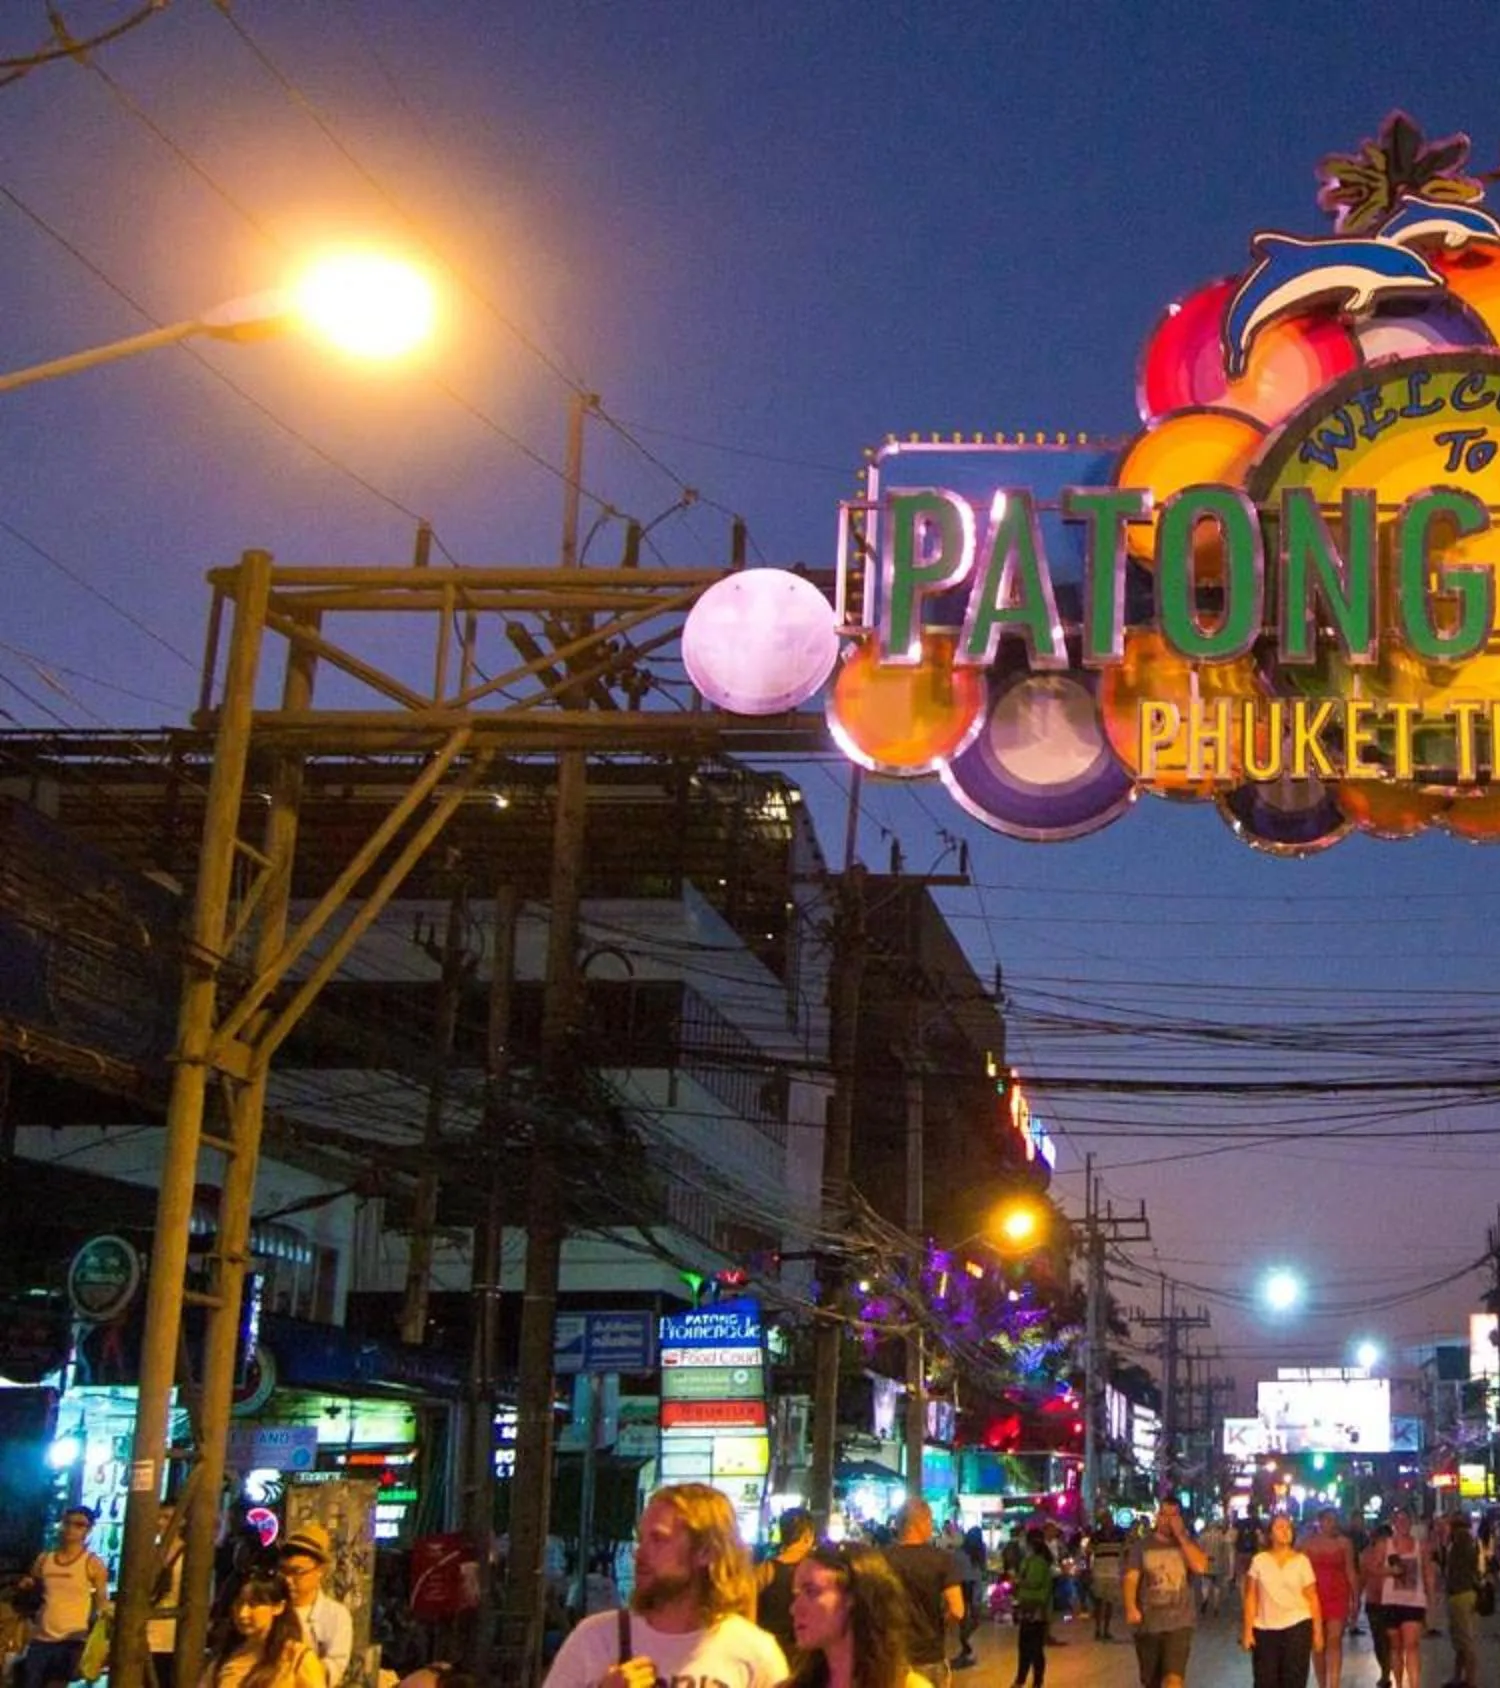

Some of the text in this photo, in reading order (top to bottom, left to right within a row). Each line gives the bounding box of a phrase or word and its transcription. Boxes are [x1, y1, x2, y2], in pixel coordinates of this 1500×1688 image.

[878, 483, 1498, 669] PATONG
[1137, 697, 1423, 783] PHUKET
[659, 1314, 761, 1340] Promenade
[685, 1313, 738, 1326] PATONG
